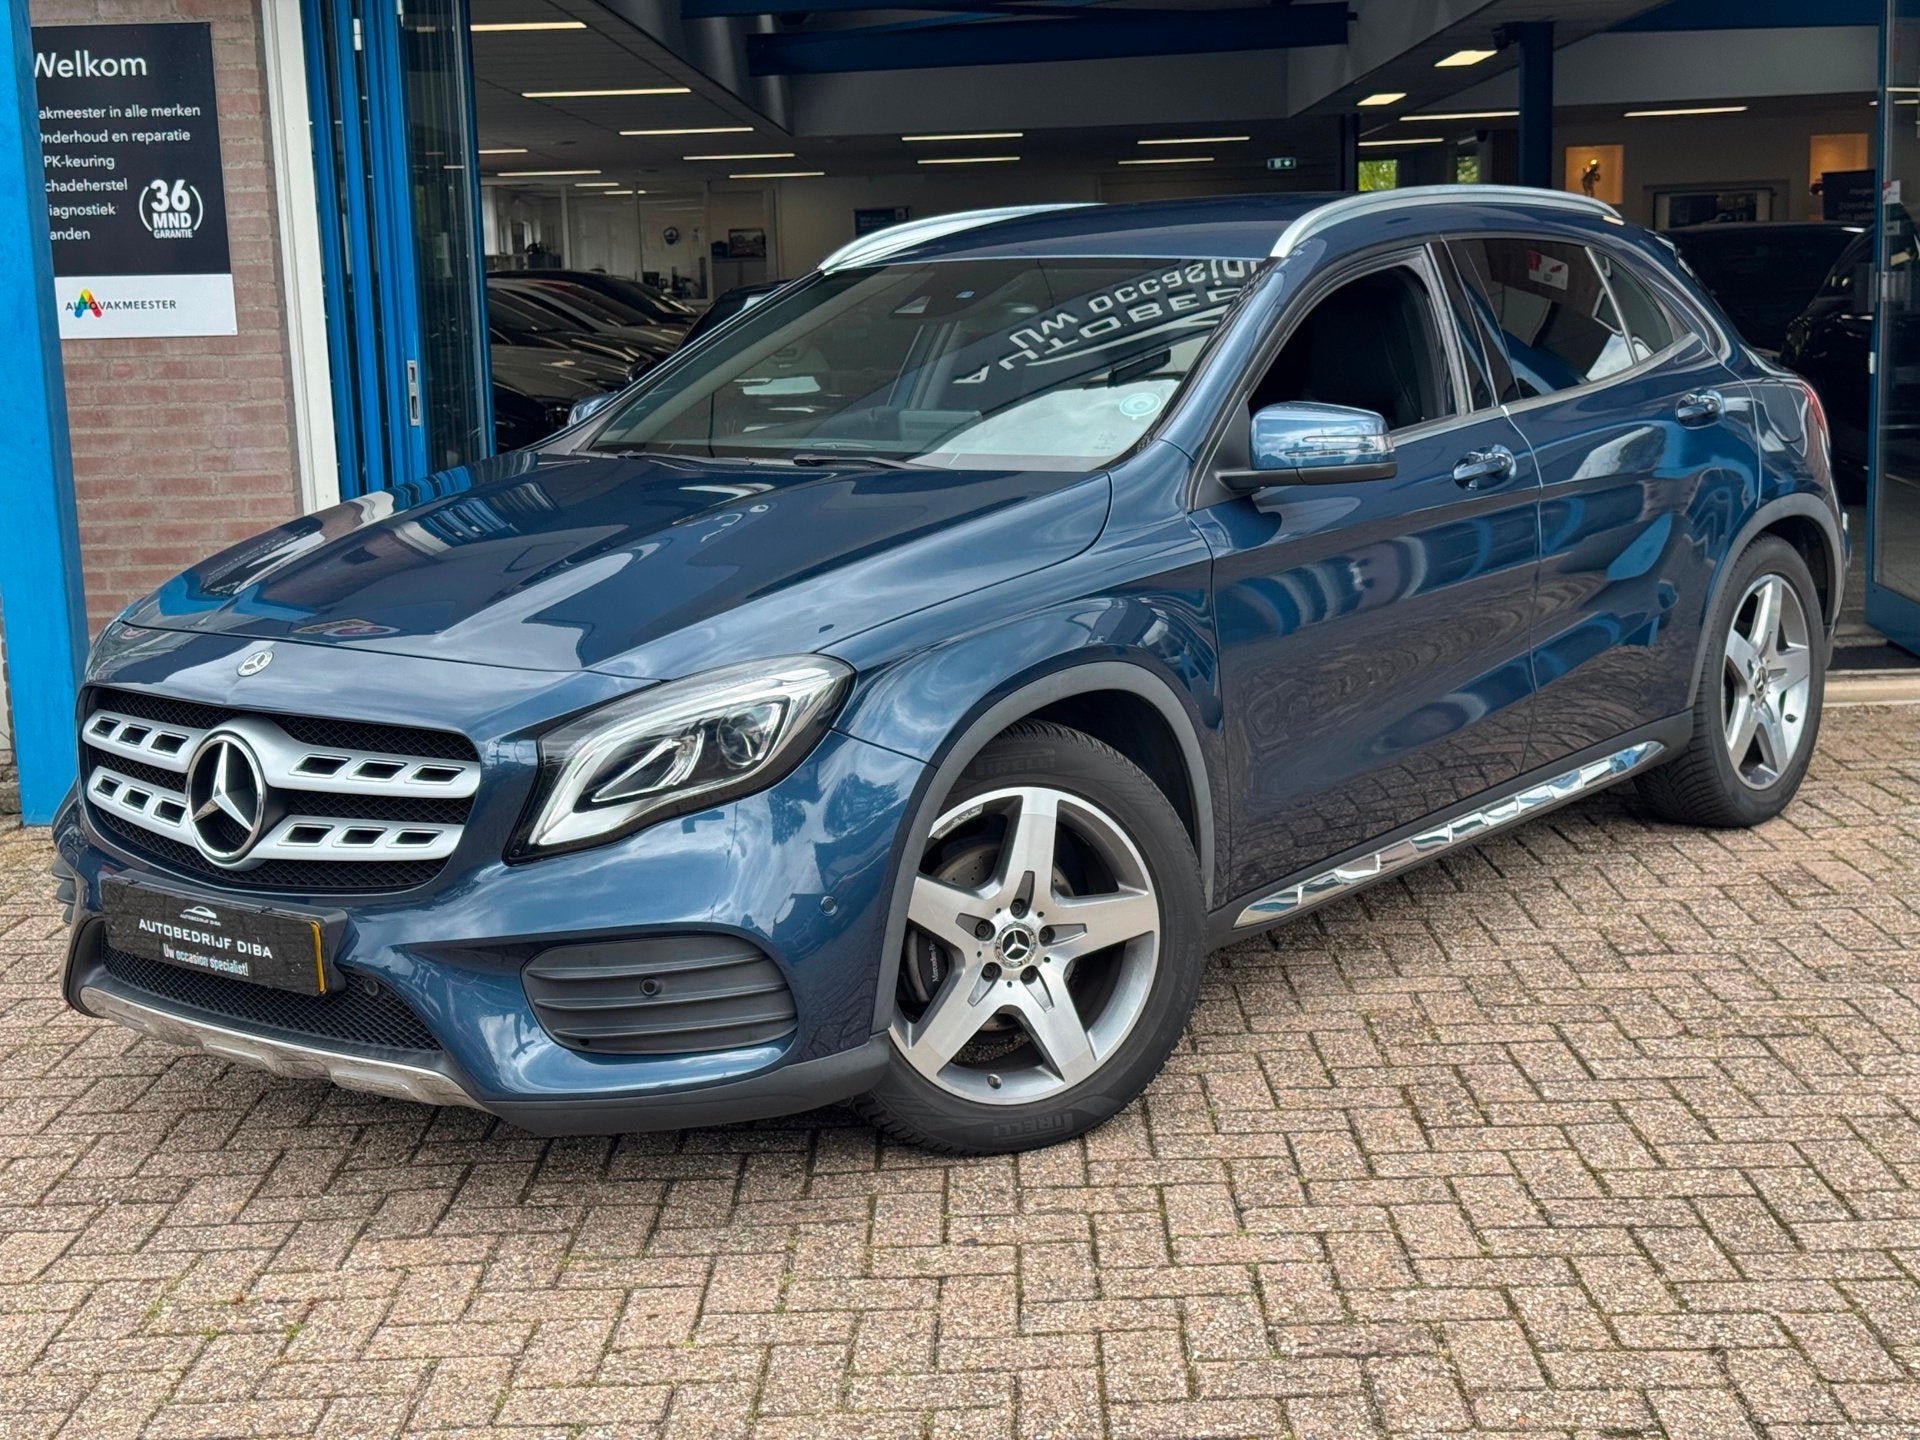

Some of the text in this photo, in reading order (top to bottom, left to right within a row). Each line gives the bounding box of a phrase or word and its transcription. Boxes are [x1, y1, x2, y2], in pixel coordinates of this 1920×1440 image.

[39, 103, 201, 120] akmeester in alle merken
[111, 133, 128, 143] en
[132, 128, 191, 145] reparatie
[44, 155, 115, 171] PK-keuring
[45, 177, 128, 193] chadeherstel
[150, 178, 191, 212] 36
[49, 203, 117, 219] iagnostiek
[152, 212, 192, 229] MND
[49, 227, 91, 241] anden
[153, 228, 193, 239] GARANTIE
[65, 299, 177, 311] AUTOVAKMEESTER
[138, 918, 273, 960] AUTOBEDRIJF DIBA
[162, 943, 249, 977] Uw occasion specialist!
